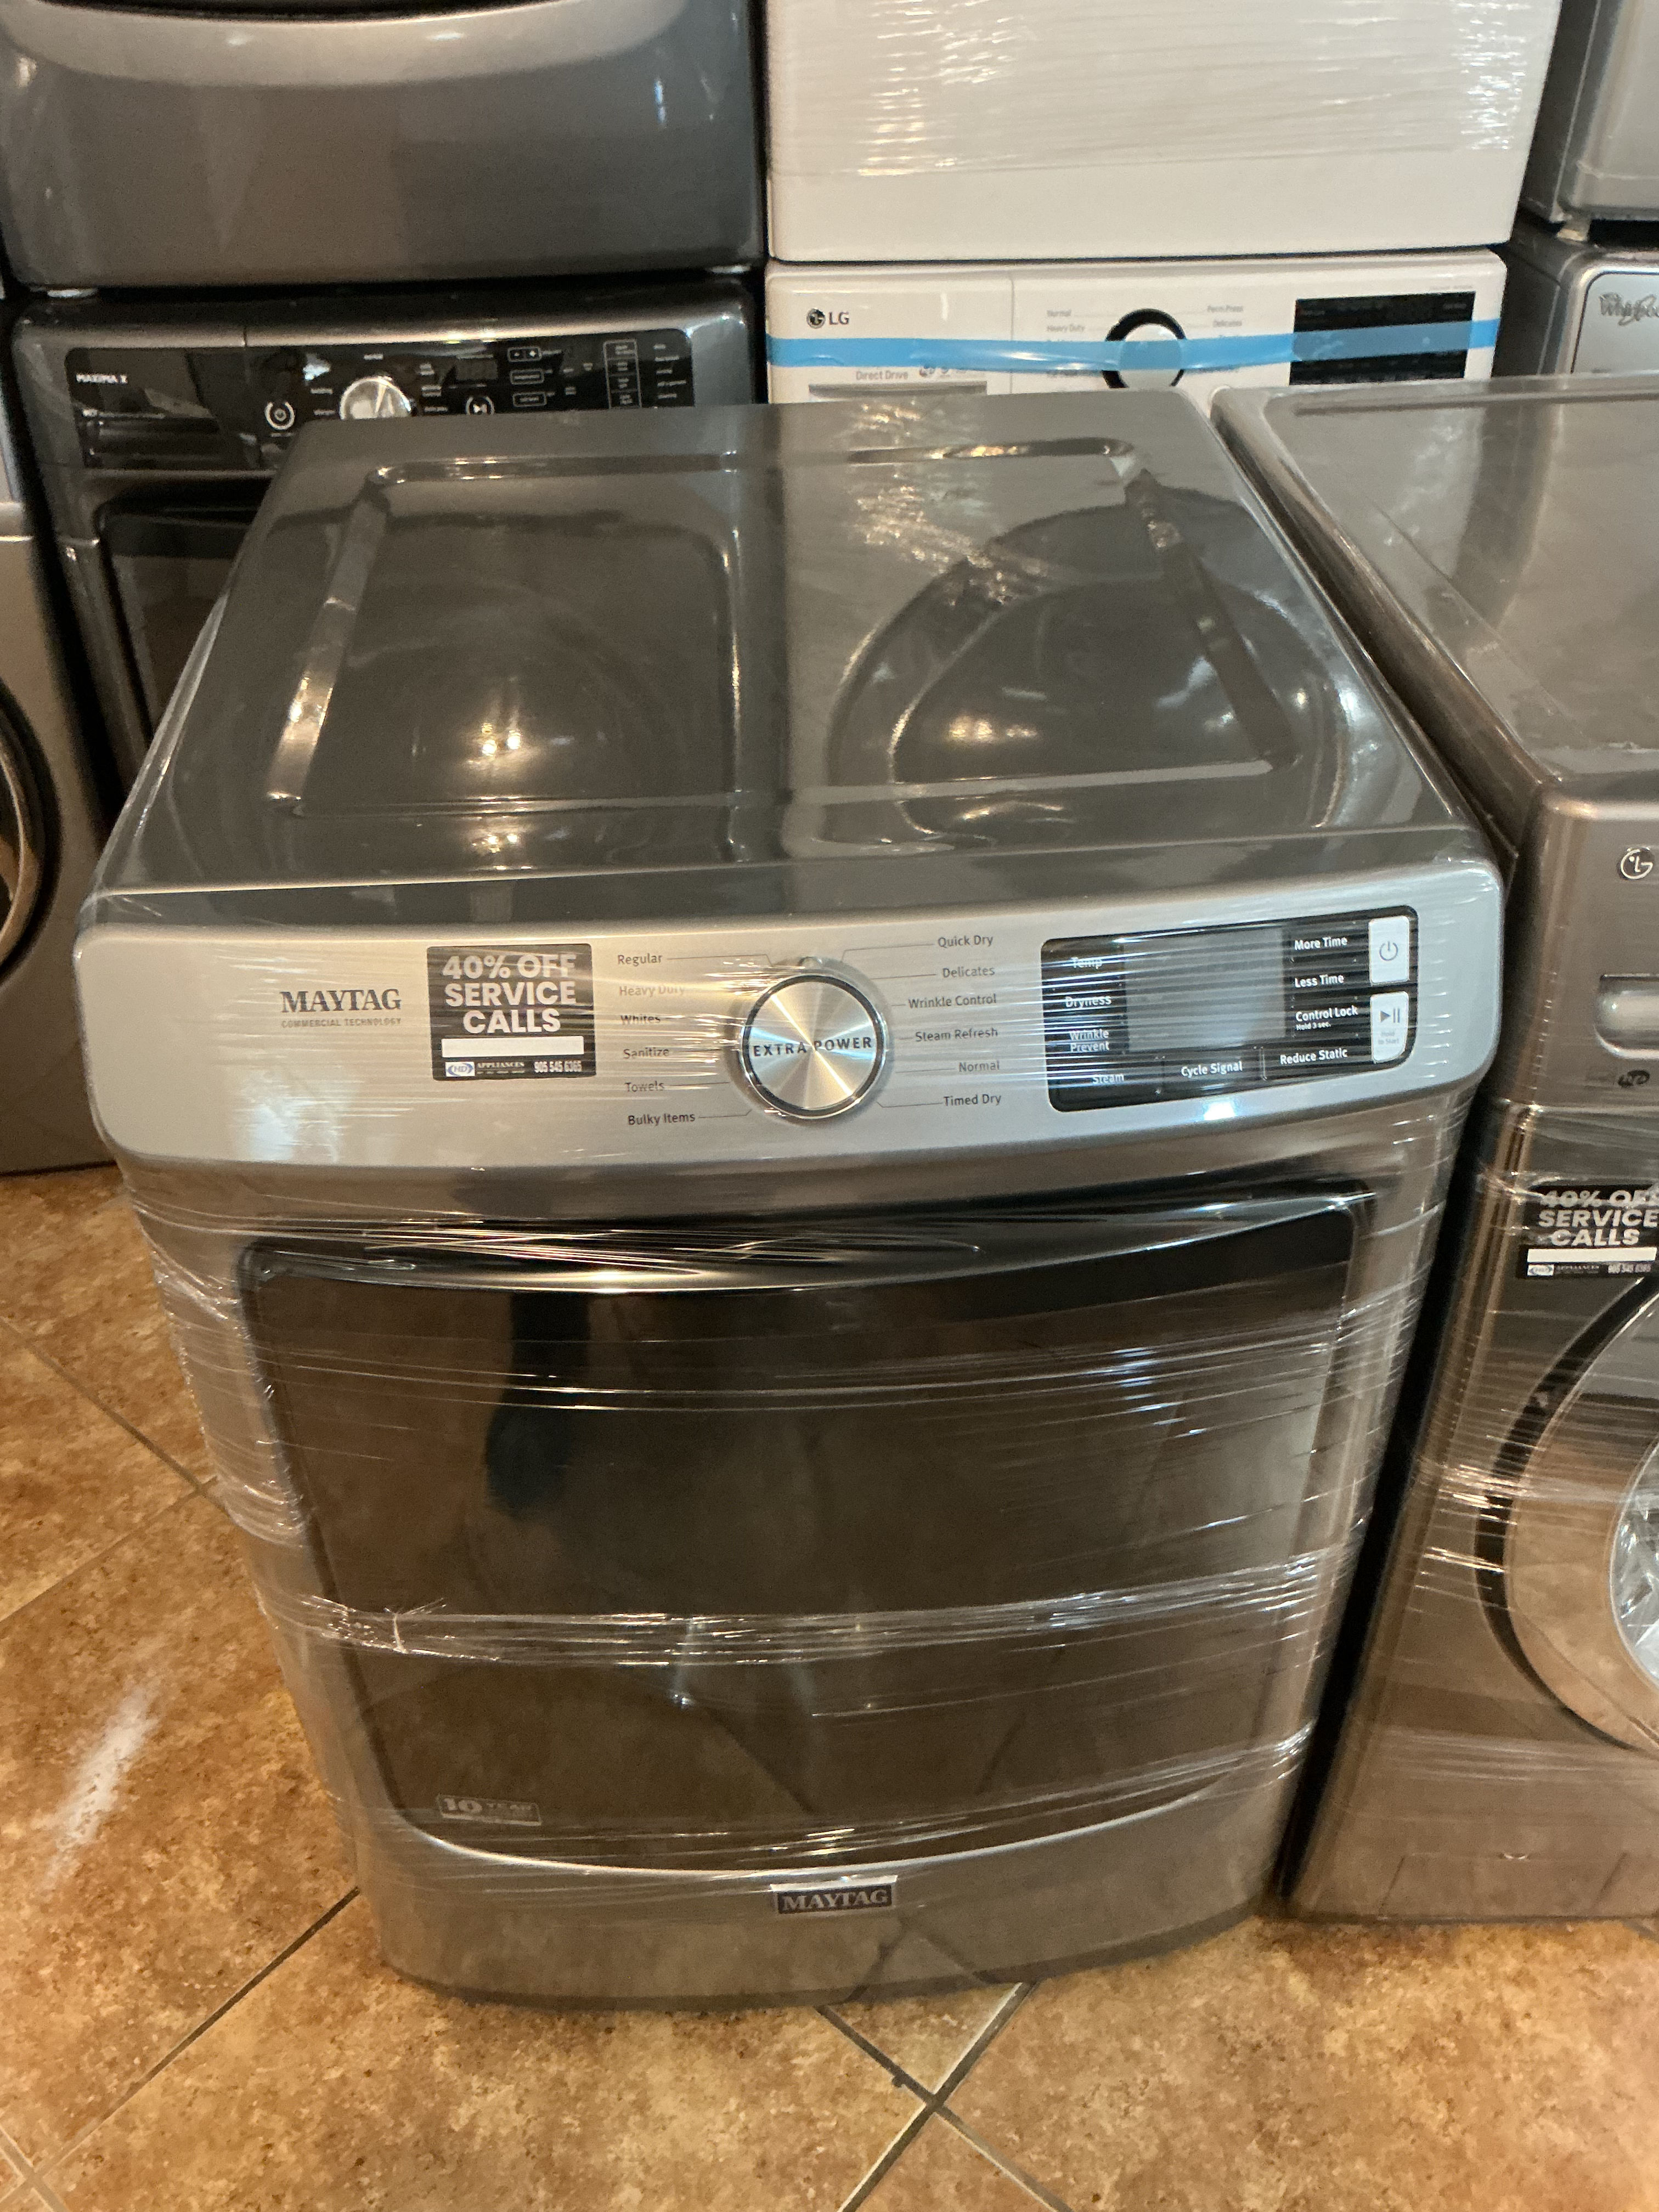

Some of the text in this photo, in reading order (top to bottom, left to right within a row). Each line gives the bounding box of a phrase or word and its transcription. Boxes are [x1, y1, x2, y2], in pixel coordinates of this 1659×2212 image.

[829, 311, 850, 325] LG
[856, 370, 882, 380] Direct
[885, 370, 909, 380] Drive
[938, 935, 994, 949] Quick Dry
[1294, 936, 1348, 951] More Time
[442, 953, 577, 979] 40% OFF
[617, 952, 663, 967] Regular
[943, 966, 996, 978] Delicates
[1295, 974, 1345, 988] Less Time
[444, 980, 577, 1007] SERVICE
[619, 985, 686, 997] Heavy Duty
[280, 988, 402, 1013] MAYTAG
[908, 993, 997, 1009] Wrinkle Control
[1064, 995, 1113, 1009] Dryness
[462, 1008, 561, 1034] CALLS
[620, 1013, 661, 1025] Whites
[1295, 1005, 1359, 1022] Control Lock
[281, 1017, 402, 1029] COMMERCIAL TECHNOLOGY
[915, 1027, 998, 1042] Steam Refresh
[1070, 1028, 1110, 1041] Wrinkle
[623, 1046, 670, 1059] Sanitize
[753, 1036, 872, 1057] EXTRA POWER
[1070, 1040, 1110, 1053] Prevent
[1280, 1047, 1348, 1065] Reduce Static
[958, 1060, 1000, 1073] Normal
[1181, 1060, 1243, 1079] Cycle Signal
[625, 1080, 665, 1092] Towels
[1092, 1073, 1125, 1085] Steam
[943, 1093, 1002, 1107] Timed Dry
[628, 1112, 696, 1127] Bulky Items
[1538, 1209, 1659, 1228] SERVICE
[1550, 1228, 1640, 1246] CALLS
[443, 1798, 483, 1813] 10
[781, 1889, 889, 1911] MAYTAG
